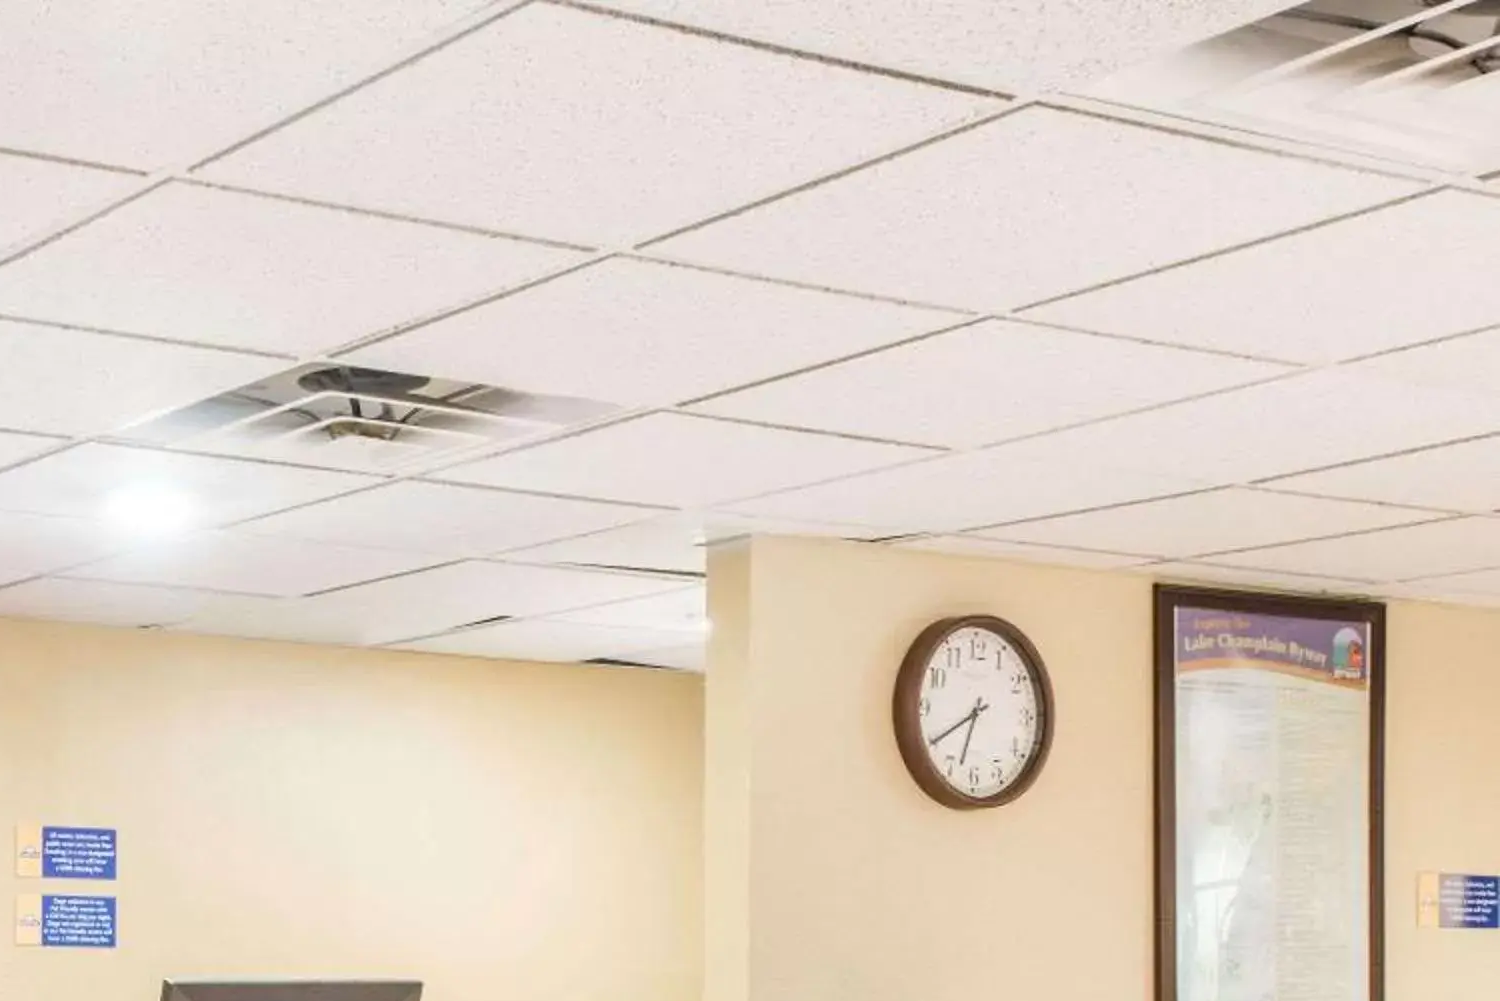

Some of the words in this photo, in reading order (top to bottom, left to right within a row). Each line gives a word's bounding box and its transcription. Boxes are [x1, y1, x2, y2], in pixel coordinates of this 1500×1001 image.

[969, 639, 986, 661] 12
[1184, 633, 1214, 652] Lake
[1217, 633, 1287, 654] Champlain
[1289, 641, 1328, 667] Byway
[930, 667, 946, 688] 10
